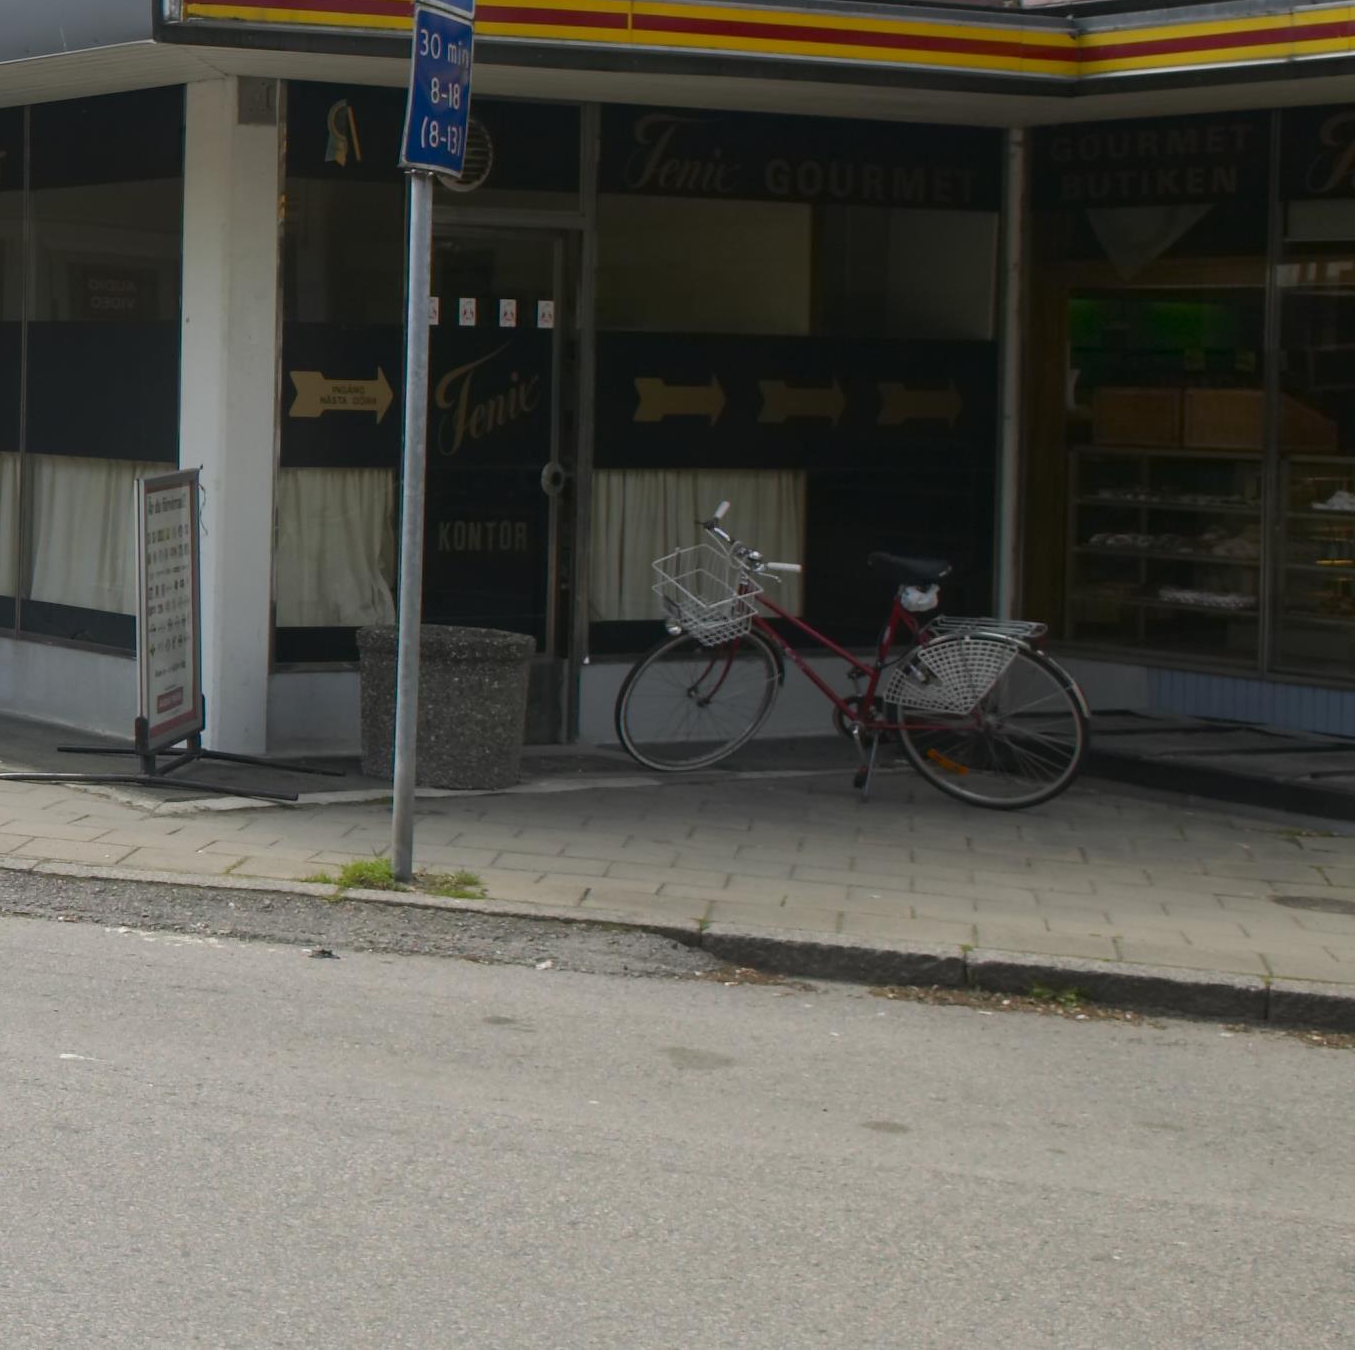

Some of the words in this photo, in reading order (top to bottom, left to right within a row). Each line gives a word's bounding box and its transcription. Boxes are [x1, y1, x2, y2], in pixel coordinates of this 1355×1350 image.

[419, 29, 441, 59] 30
[447, 40, 470, 70] min
[430, 77, 460, 110] 8-18
[420, 116, 462, 157] (8-13)
[1050, 122, 1254, 163] GOURMET
[763, 158, 978, 204] GOURMET
[1059, 165, 1240, 202] BUTIKEN
[438, 519, 529, 552] KONTOR
